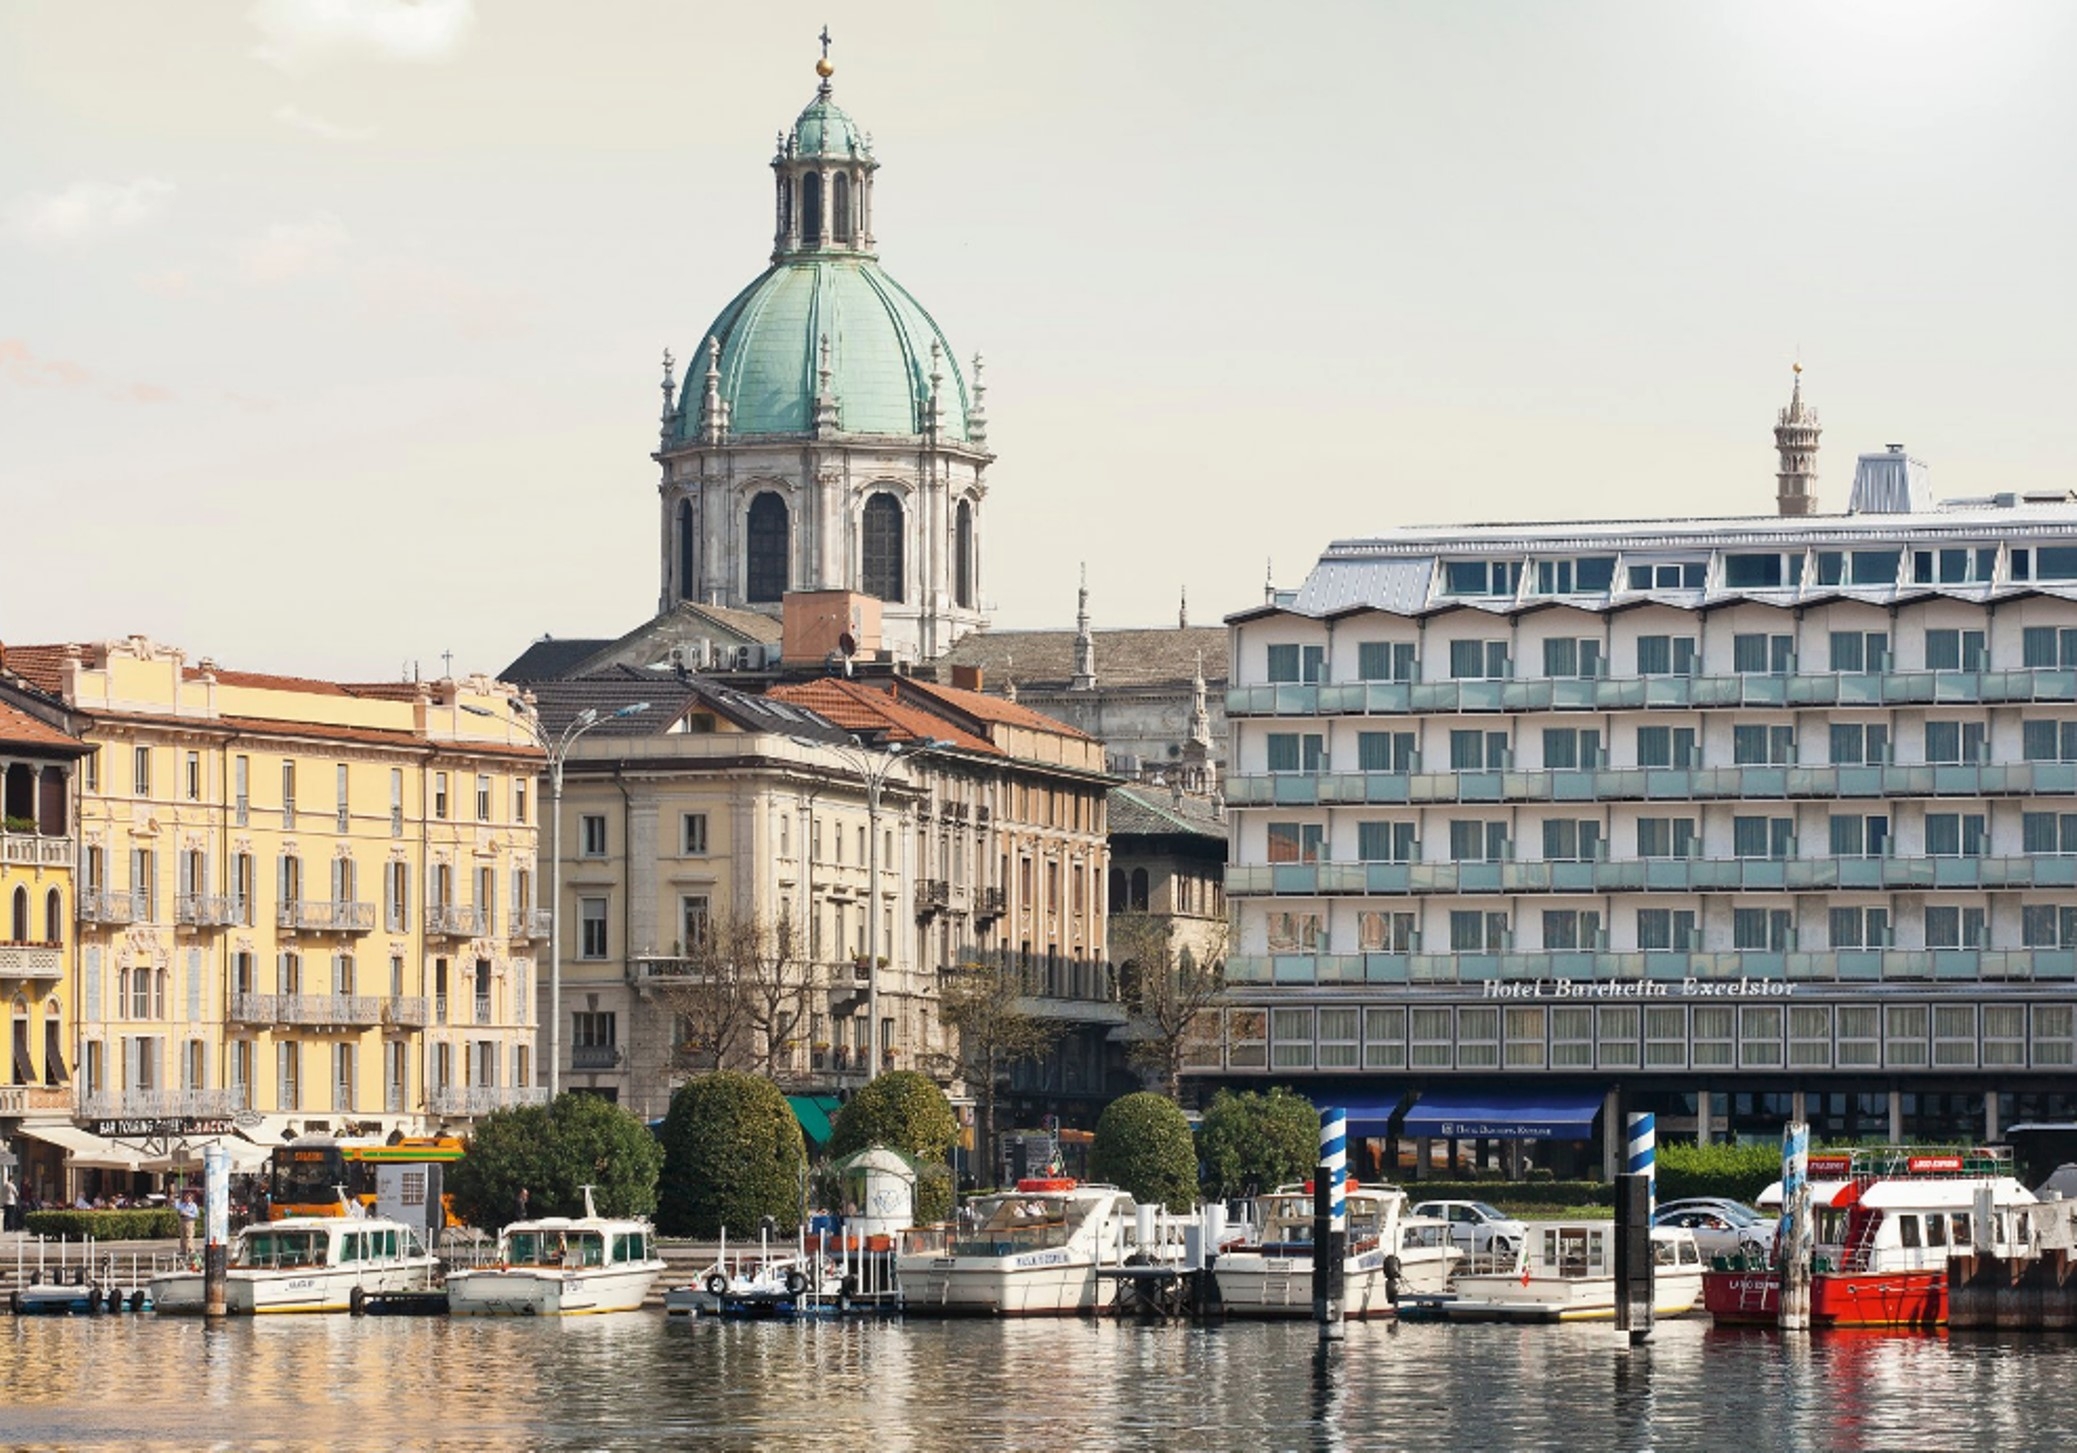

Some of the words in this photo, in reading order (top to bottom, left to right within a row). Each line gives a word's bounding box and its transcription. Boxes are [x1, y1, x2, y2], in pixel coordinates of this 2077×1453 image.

[1482, 978, 1543, 998] Hotel
[1554, 978, 1668, 998] Barchetta
[1681, 977, 1798, 997] Excelsior
